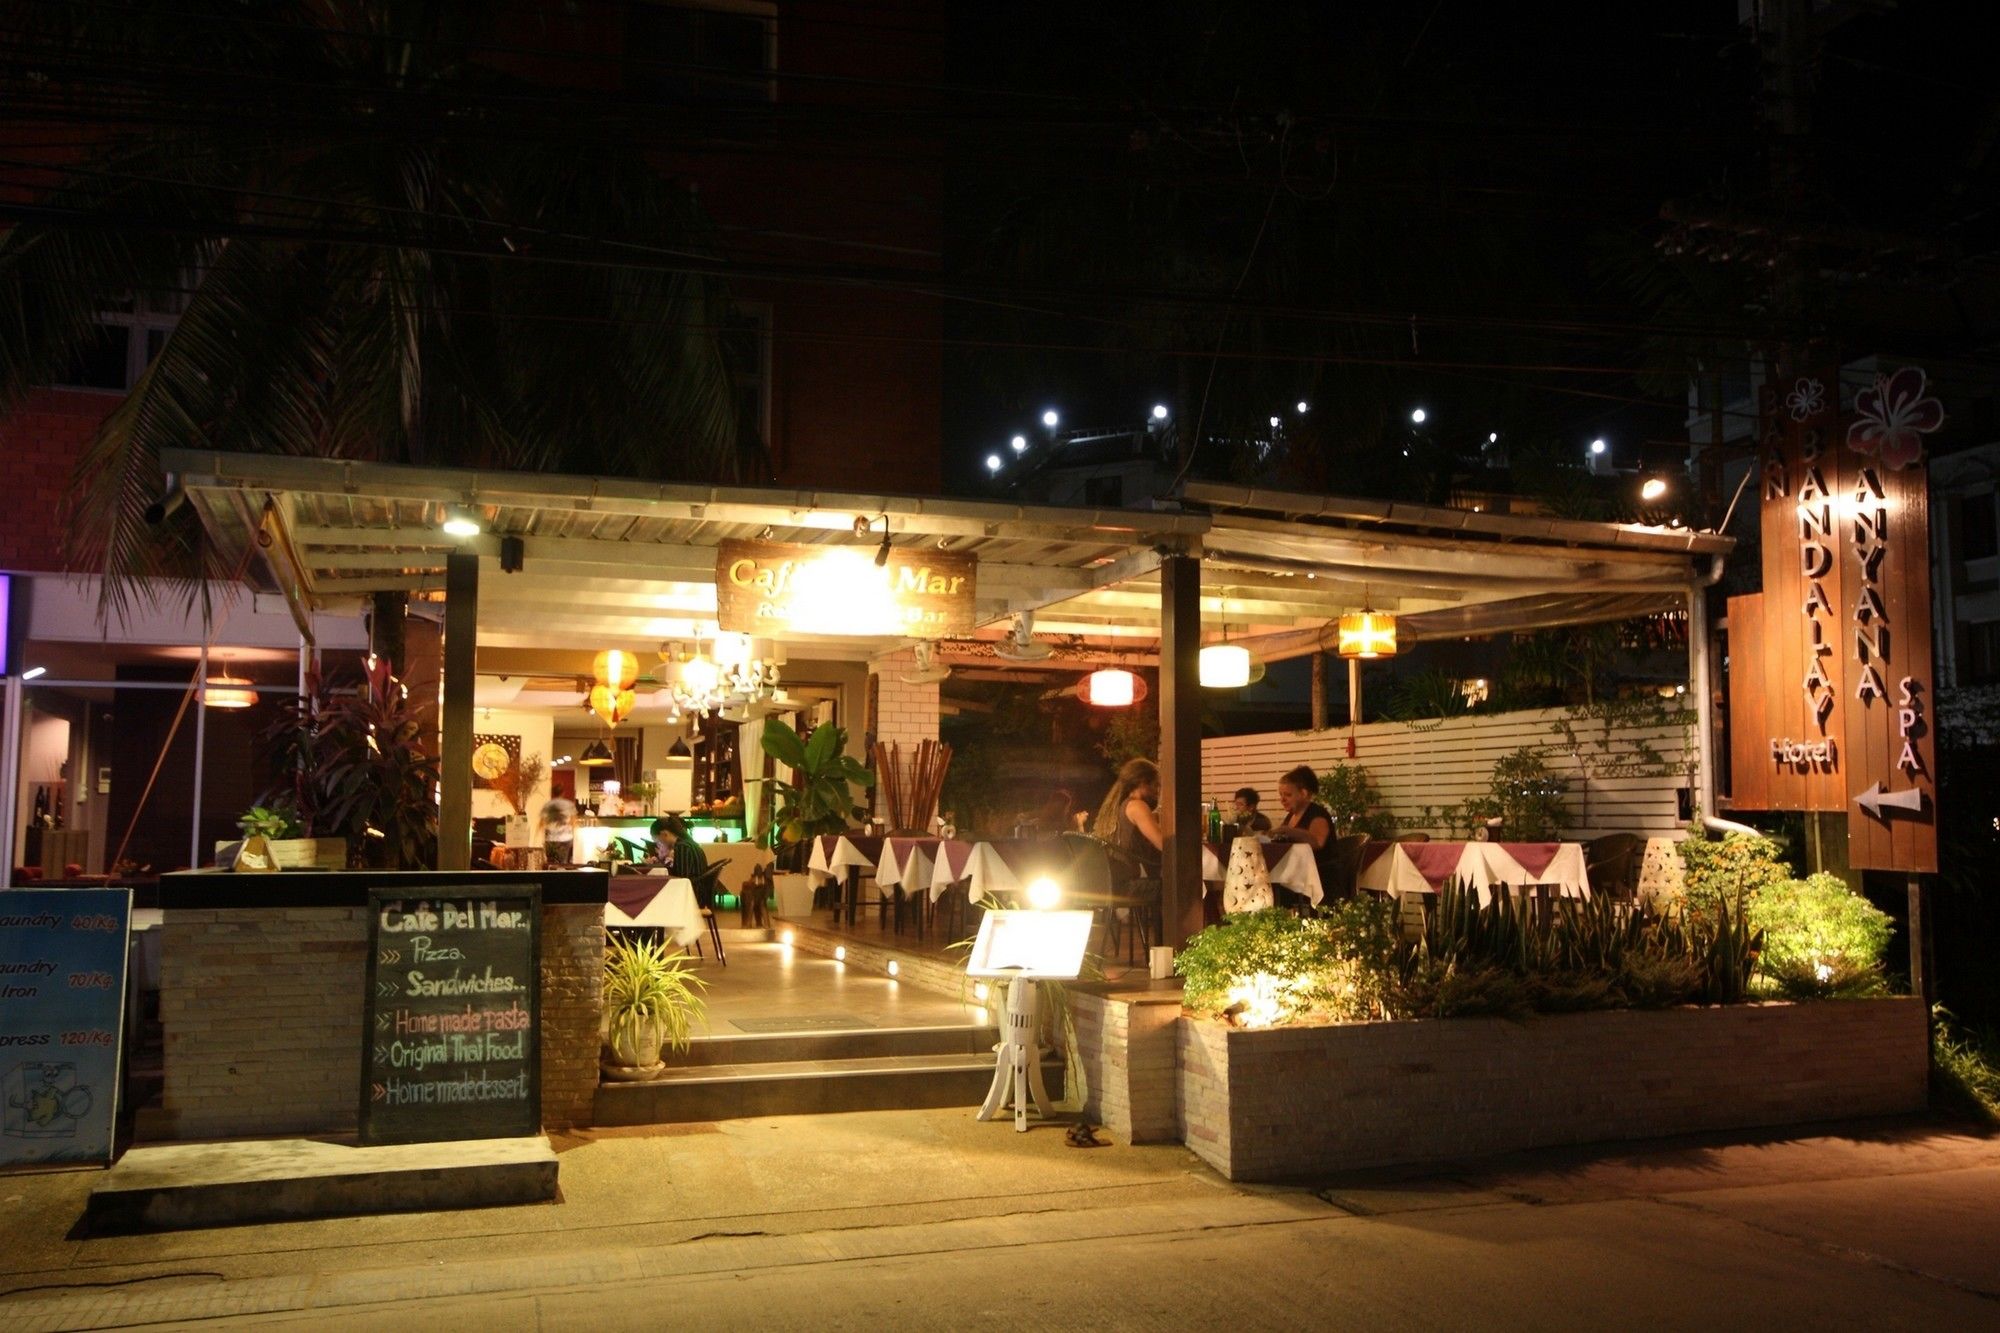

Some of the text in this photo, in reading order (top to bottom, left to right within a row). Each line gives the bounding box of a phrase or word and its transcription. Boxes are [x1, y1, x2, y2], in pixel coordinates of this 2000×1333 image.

[729, 559, 808, 598] Caf
[896, 566, 965, 594] Mar
[1850, 467, 1882, 700] ANYANA
[1897, 676, 1920, 770] SPA
[1770, 736, 1833, 763] Hotel
[1, 984, 38, 998] Iron
[391, 1034, 448, 1071] Original
[451, 1033, 483, 1062] Thai
